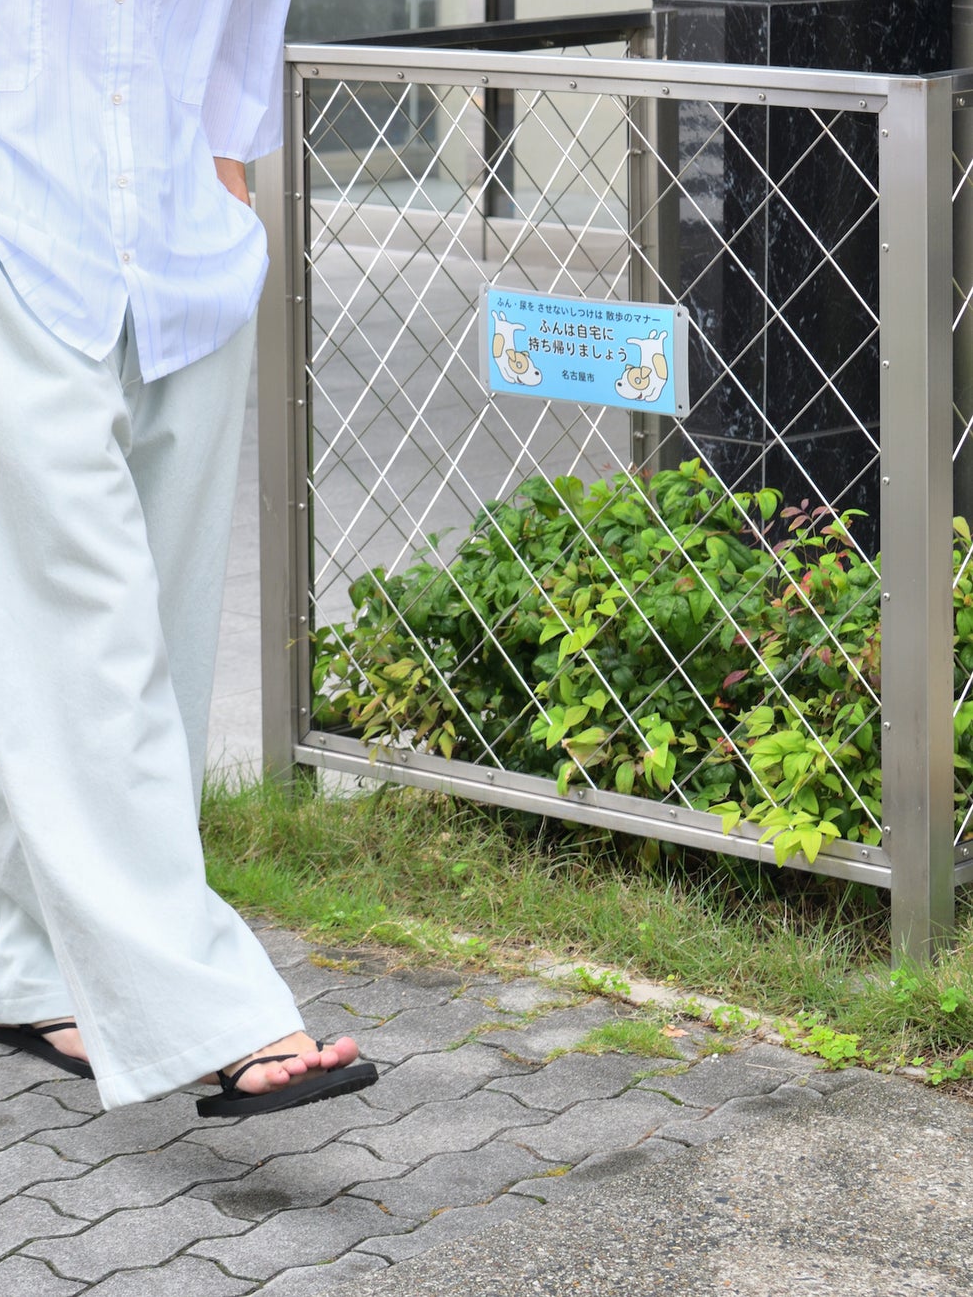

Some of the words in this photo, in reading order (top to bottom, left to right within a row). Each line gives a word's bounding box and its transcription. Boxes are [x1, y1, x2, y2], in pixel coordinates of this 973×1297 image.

[537, 303, 603, 320] させないしつけは
[605, 311, 661, 324] 散歩のマナー
[539, 319, 614, 341] ふんは自宅に
[528, 336, 628, 363] 持ち帰りましょう
[561, 369, 596, 383] 名古屋市
